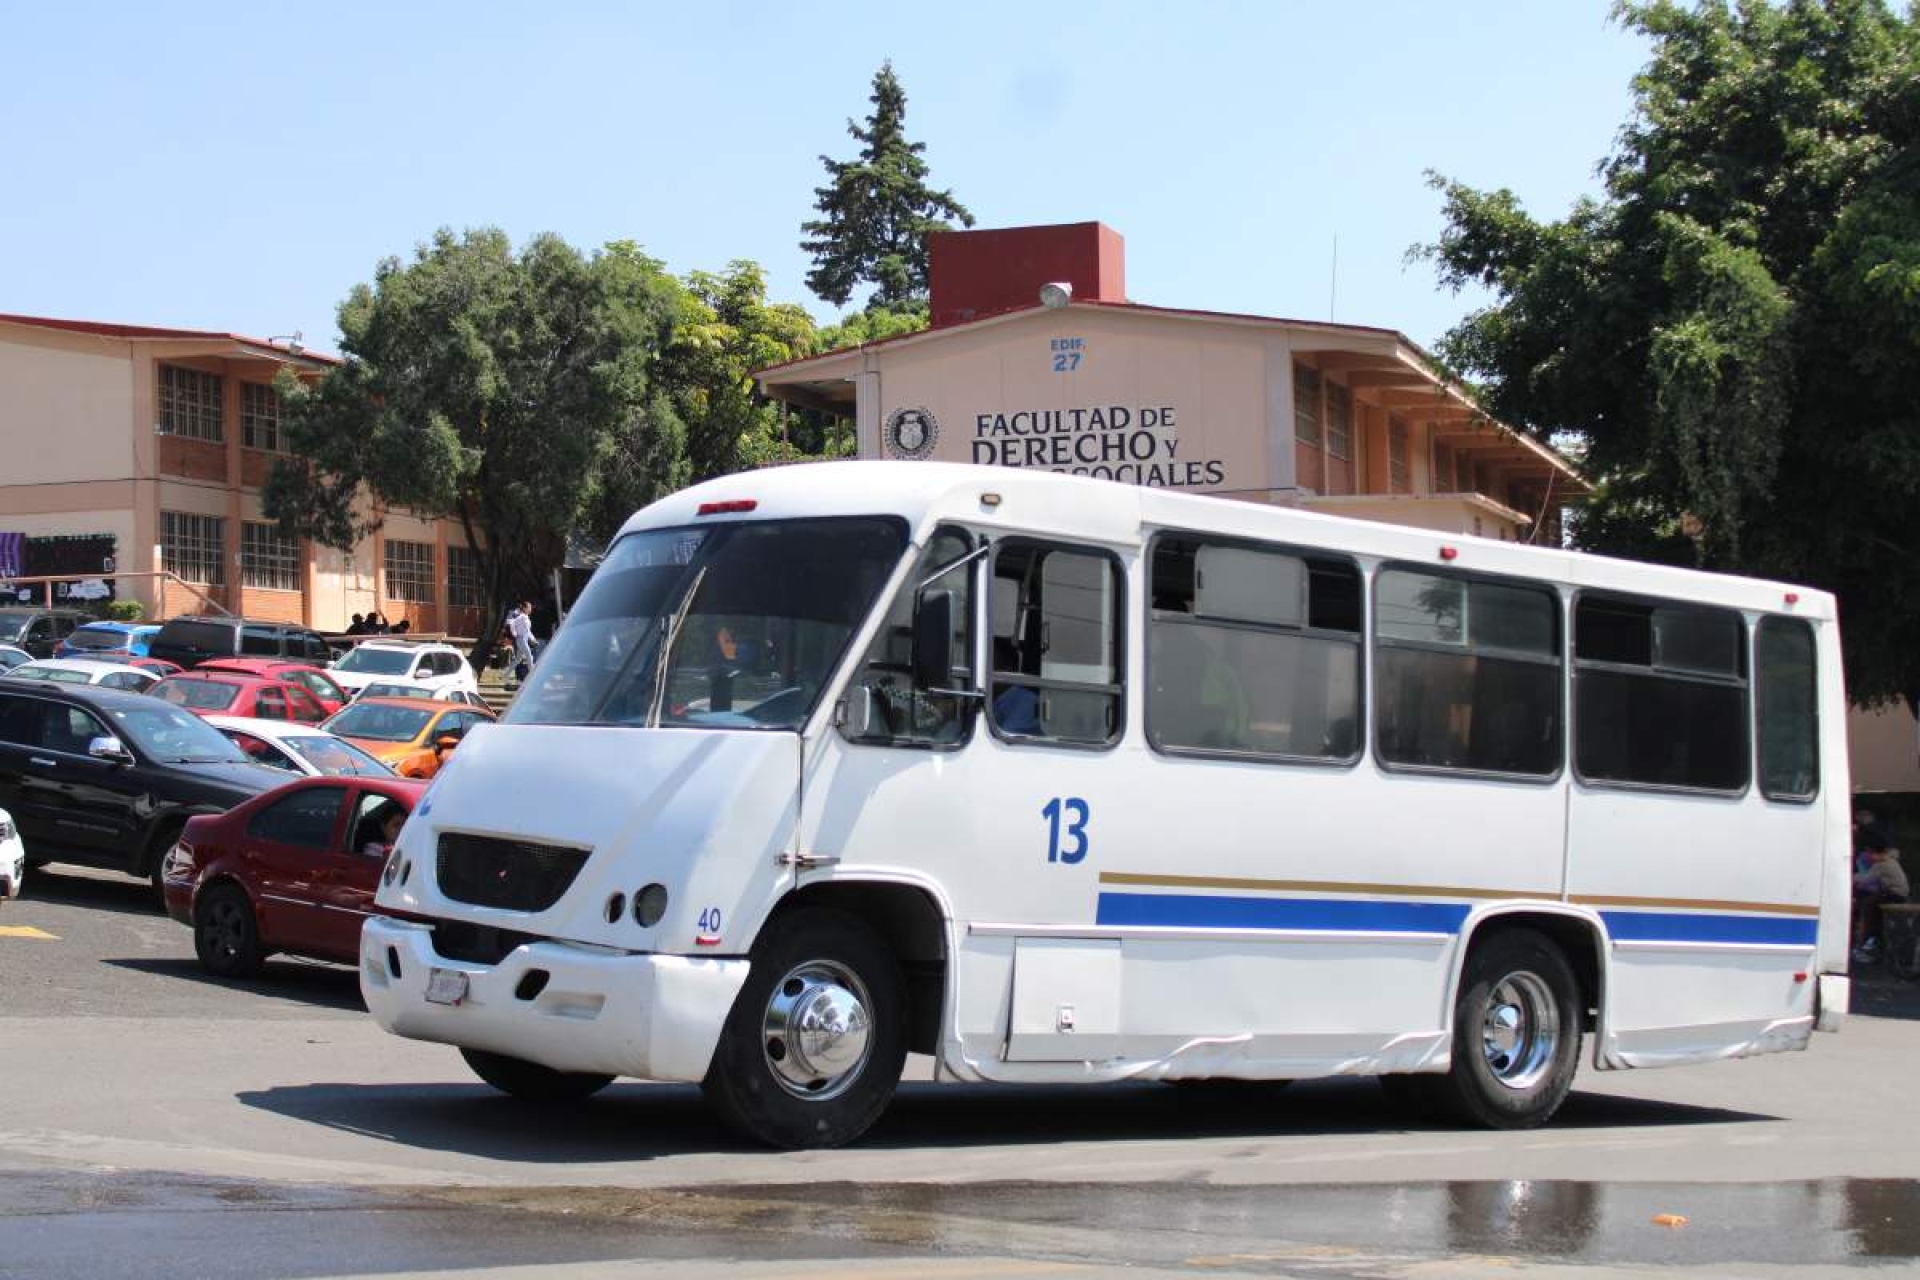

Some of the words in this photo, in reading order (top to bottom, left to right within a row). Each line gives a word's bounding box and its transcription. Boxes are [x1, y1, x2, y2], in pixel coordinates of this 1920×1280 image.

[1053, 353, 1082, 371] 27
[976, 407, 1131, 438] FACULTAD
[1140, 407, 1176, 428] DE
[972, 430, 1156, 467] DERECHO
[1164, 439, 1178, 459] Y
[1072, 460, 1225, 487] OCIALES
[1041, 797, 1090, 864] 13
[698, 908, 721, 933] 40
